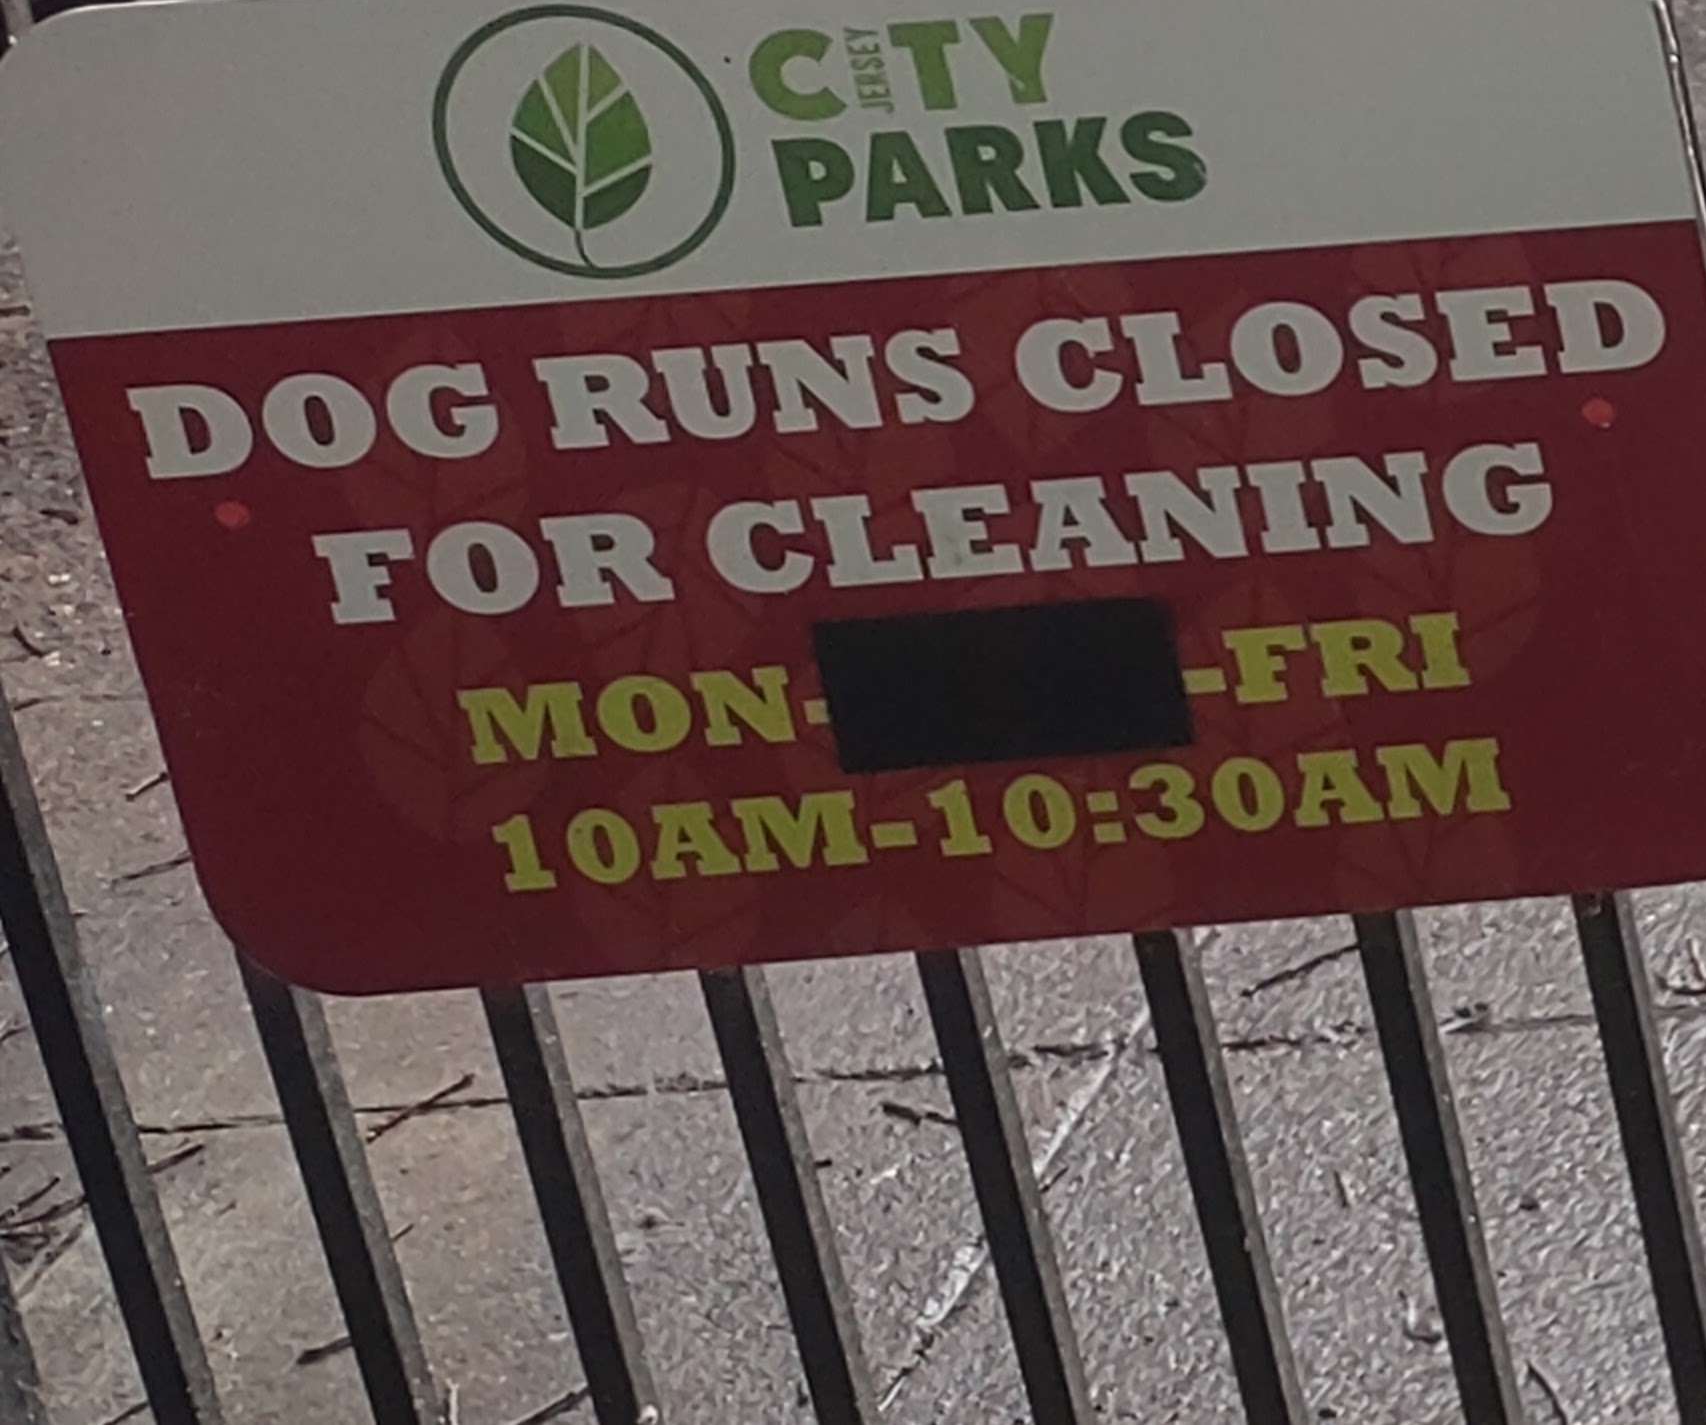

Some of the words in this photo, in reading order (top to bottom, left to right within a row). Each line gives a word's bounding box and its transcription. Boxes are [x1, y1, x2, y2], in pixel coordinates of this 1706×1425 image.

[843, 25, 895, 116] JERSEY
[771, 110, 1208, 228] PARKS
[126, 362, 500, 480] DOG
[533, 328, 977, 450] RUNS
[1015, 277, 1667, 414] CLOSED
[311, 512, 677, 625] FOR
[707, 441, 1555, 596] CLEANING
[493, 736, 1513, 893] 10AM-10:30AM
